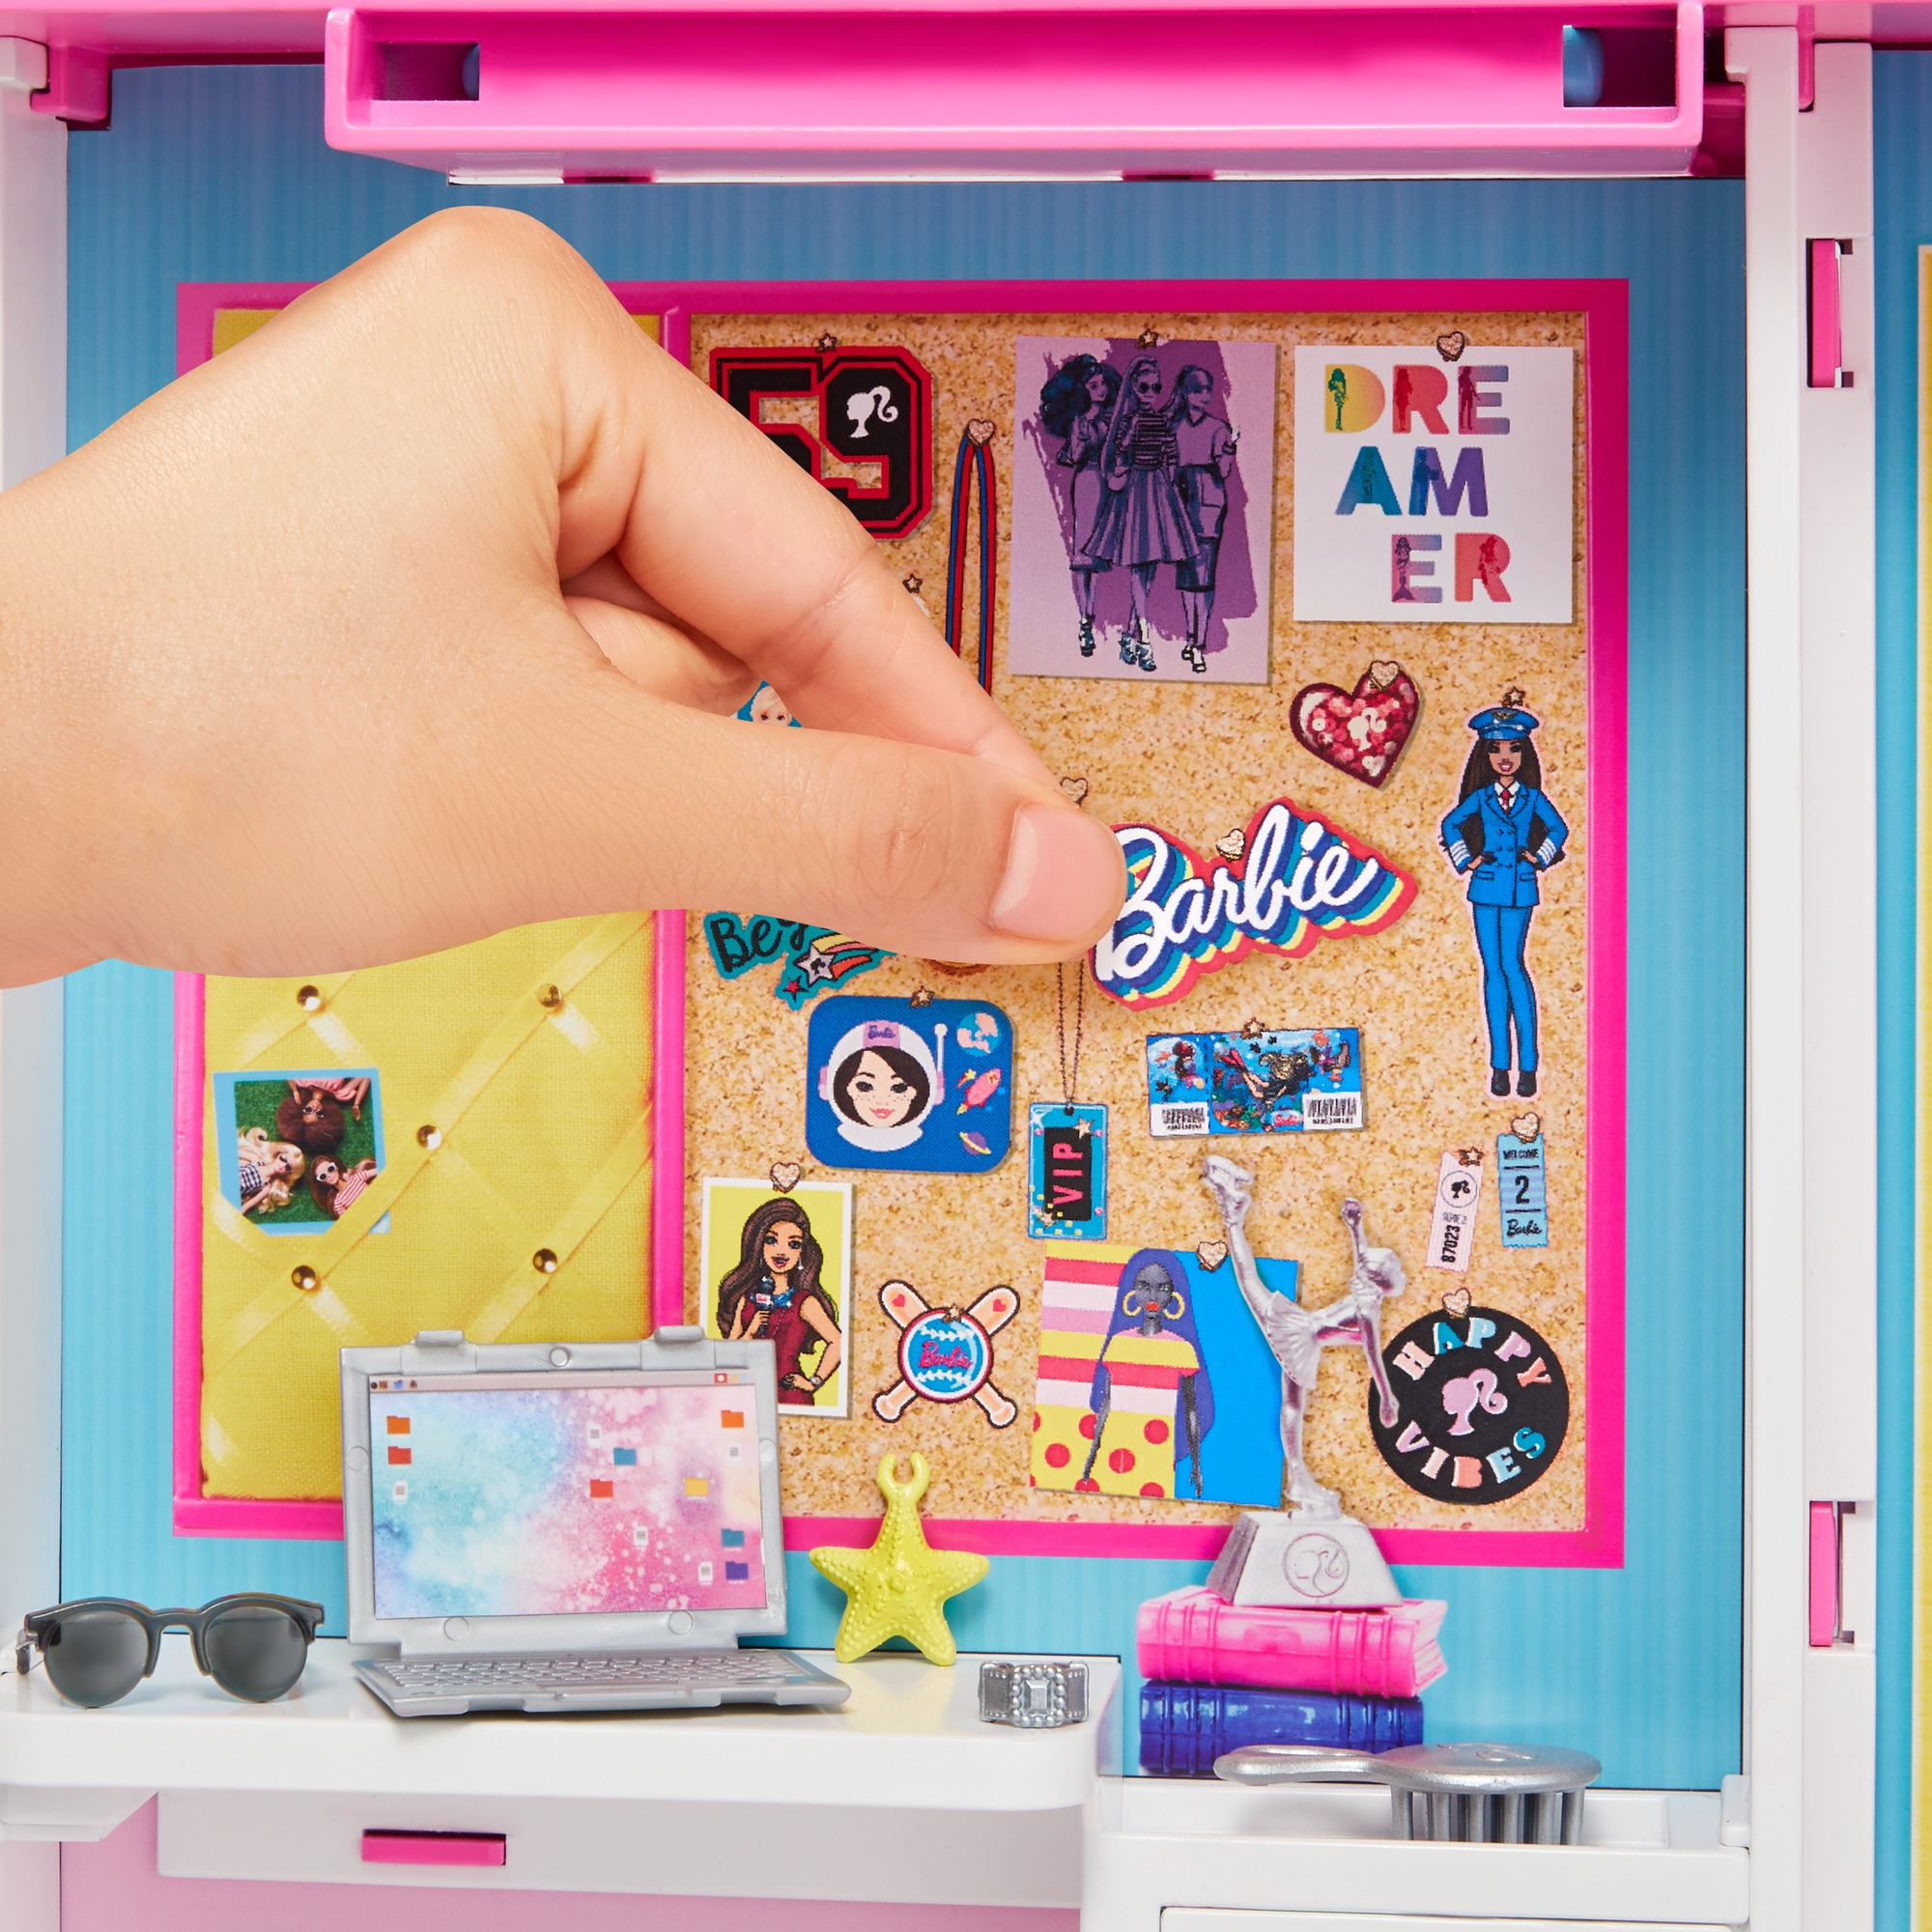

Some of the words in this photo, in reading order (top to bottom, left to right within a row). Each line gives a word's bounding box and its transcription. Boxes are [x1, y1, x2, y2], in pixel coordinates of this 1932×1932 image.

[1325, 363, 1511, 435] DRE
[1335, 445, 1490, 517] AM
[1391, 532, 1512, 604] ER
[1094, 803, 1383, 984] Barbie
[1052, 1142, 1084, 1206] VIP
[1502, 1148, 1539, 1160] WELCOME
[1514, 1174, 1530, 1205] 2
[1440, 1224, 1461, 1264] 87023
[1506, 1219, 1543, 1237] Barbie
[918, 1340, 974, 1370] Barbie
[1391, 1316, 1552, 1388] HAPPY
[1394, 1419, 1547, 1490] VIBES
